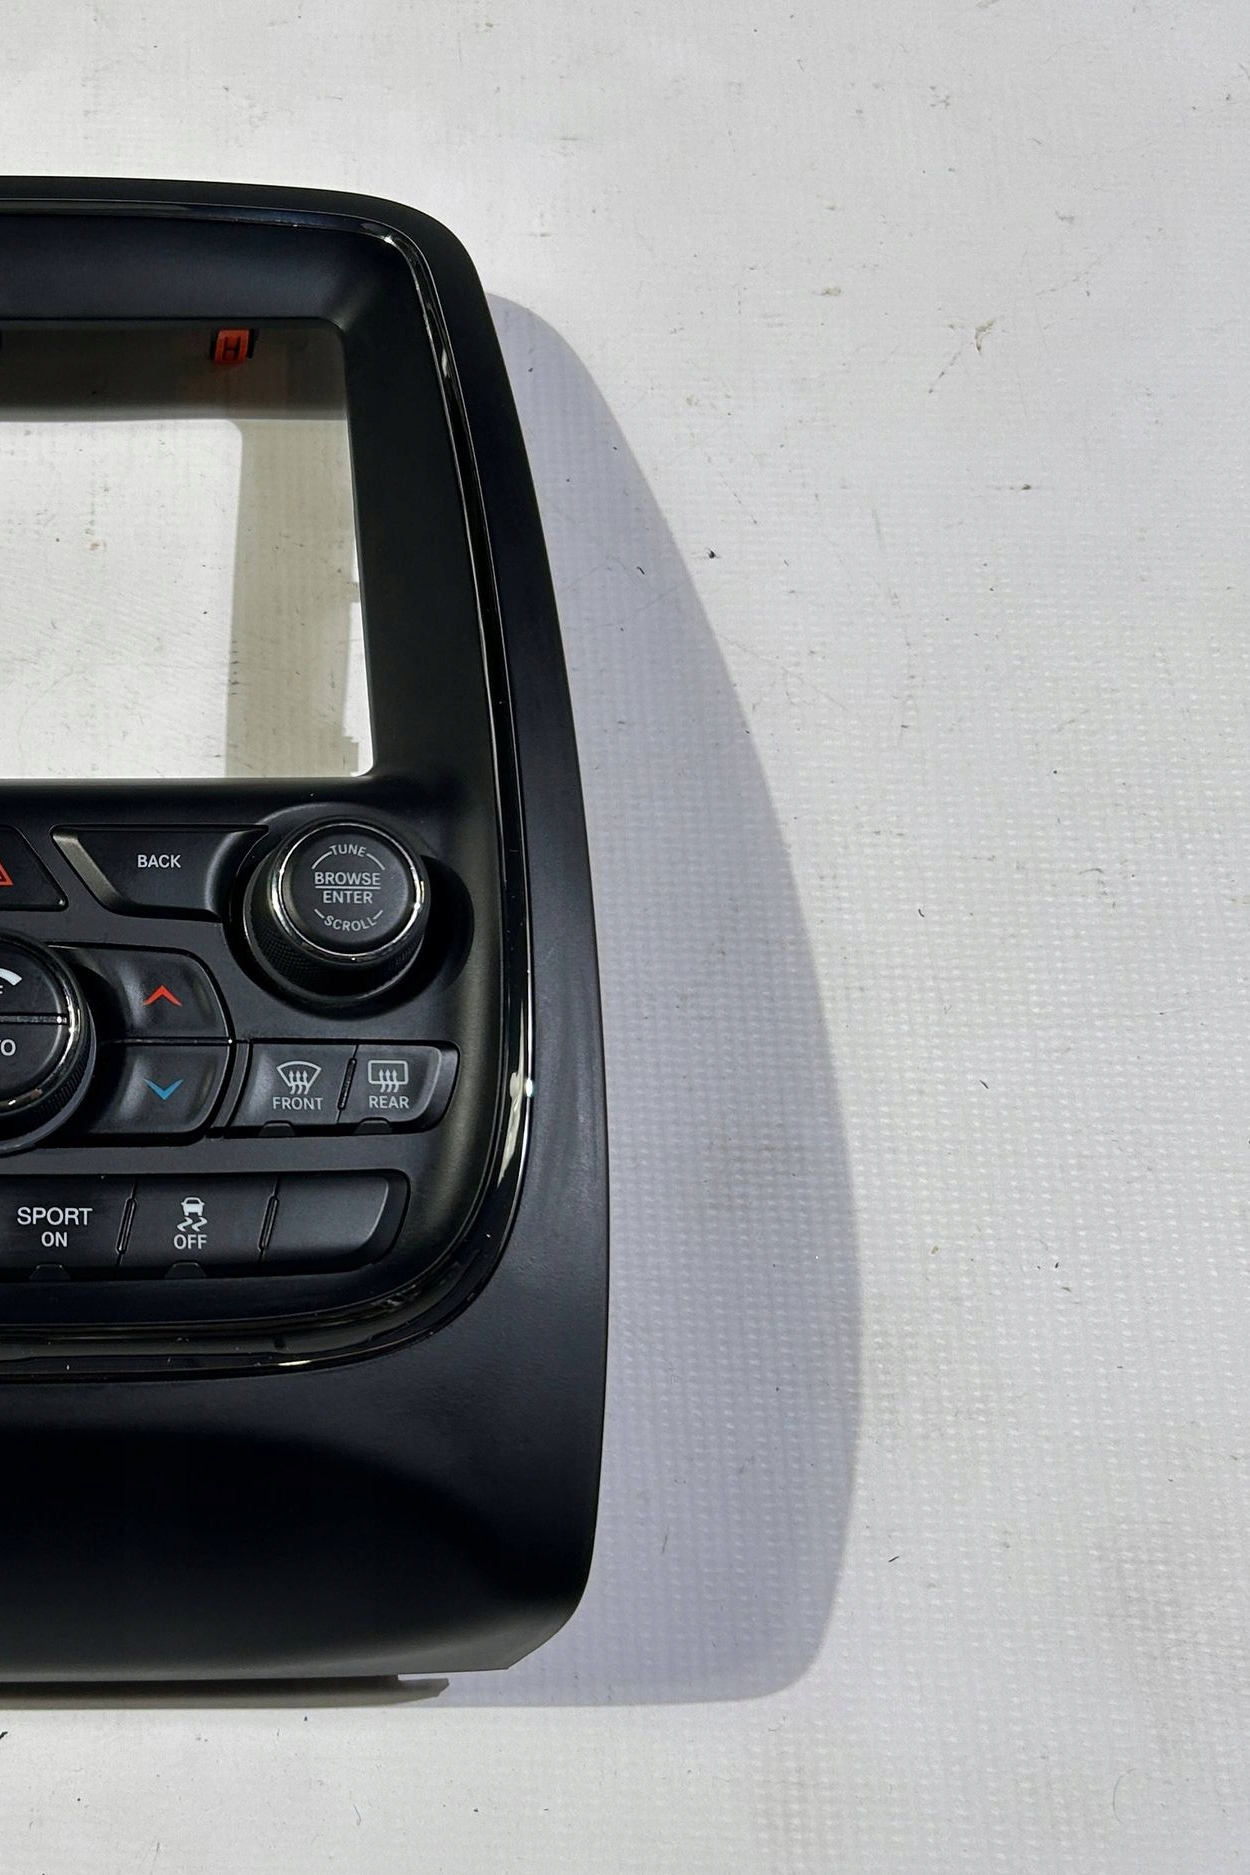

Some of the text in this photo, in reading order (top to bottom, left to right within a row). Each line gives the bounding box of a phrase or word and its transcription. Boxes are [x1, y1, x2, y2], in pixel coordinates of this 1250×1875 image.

[329, 844, 366, 858] TUNE
[137, 854, 181, 869] BACK
[314, 871, 381, 886] BROWSE
[322, 890, 373, 904] ENTER
[324, 914, 377, 932] SCROLL
[272, 1097, 324, 1112] FRONT
[368, 1095, 410, 1110] REAR
[17, 1206, 93, 1226] SPORT
[41, 1231, 68, 1248] ON
[173, 1234, 208, 1250] OFF
